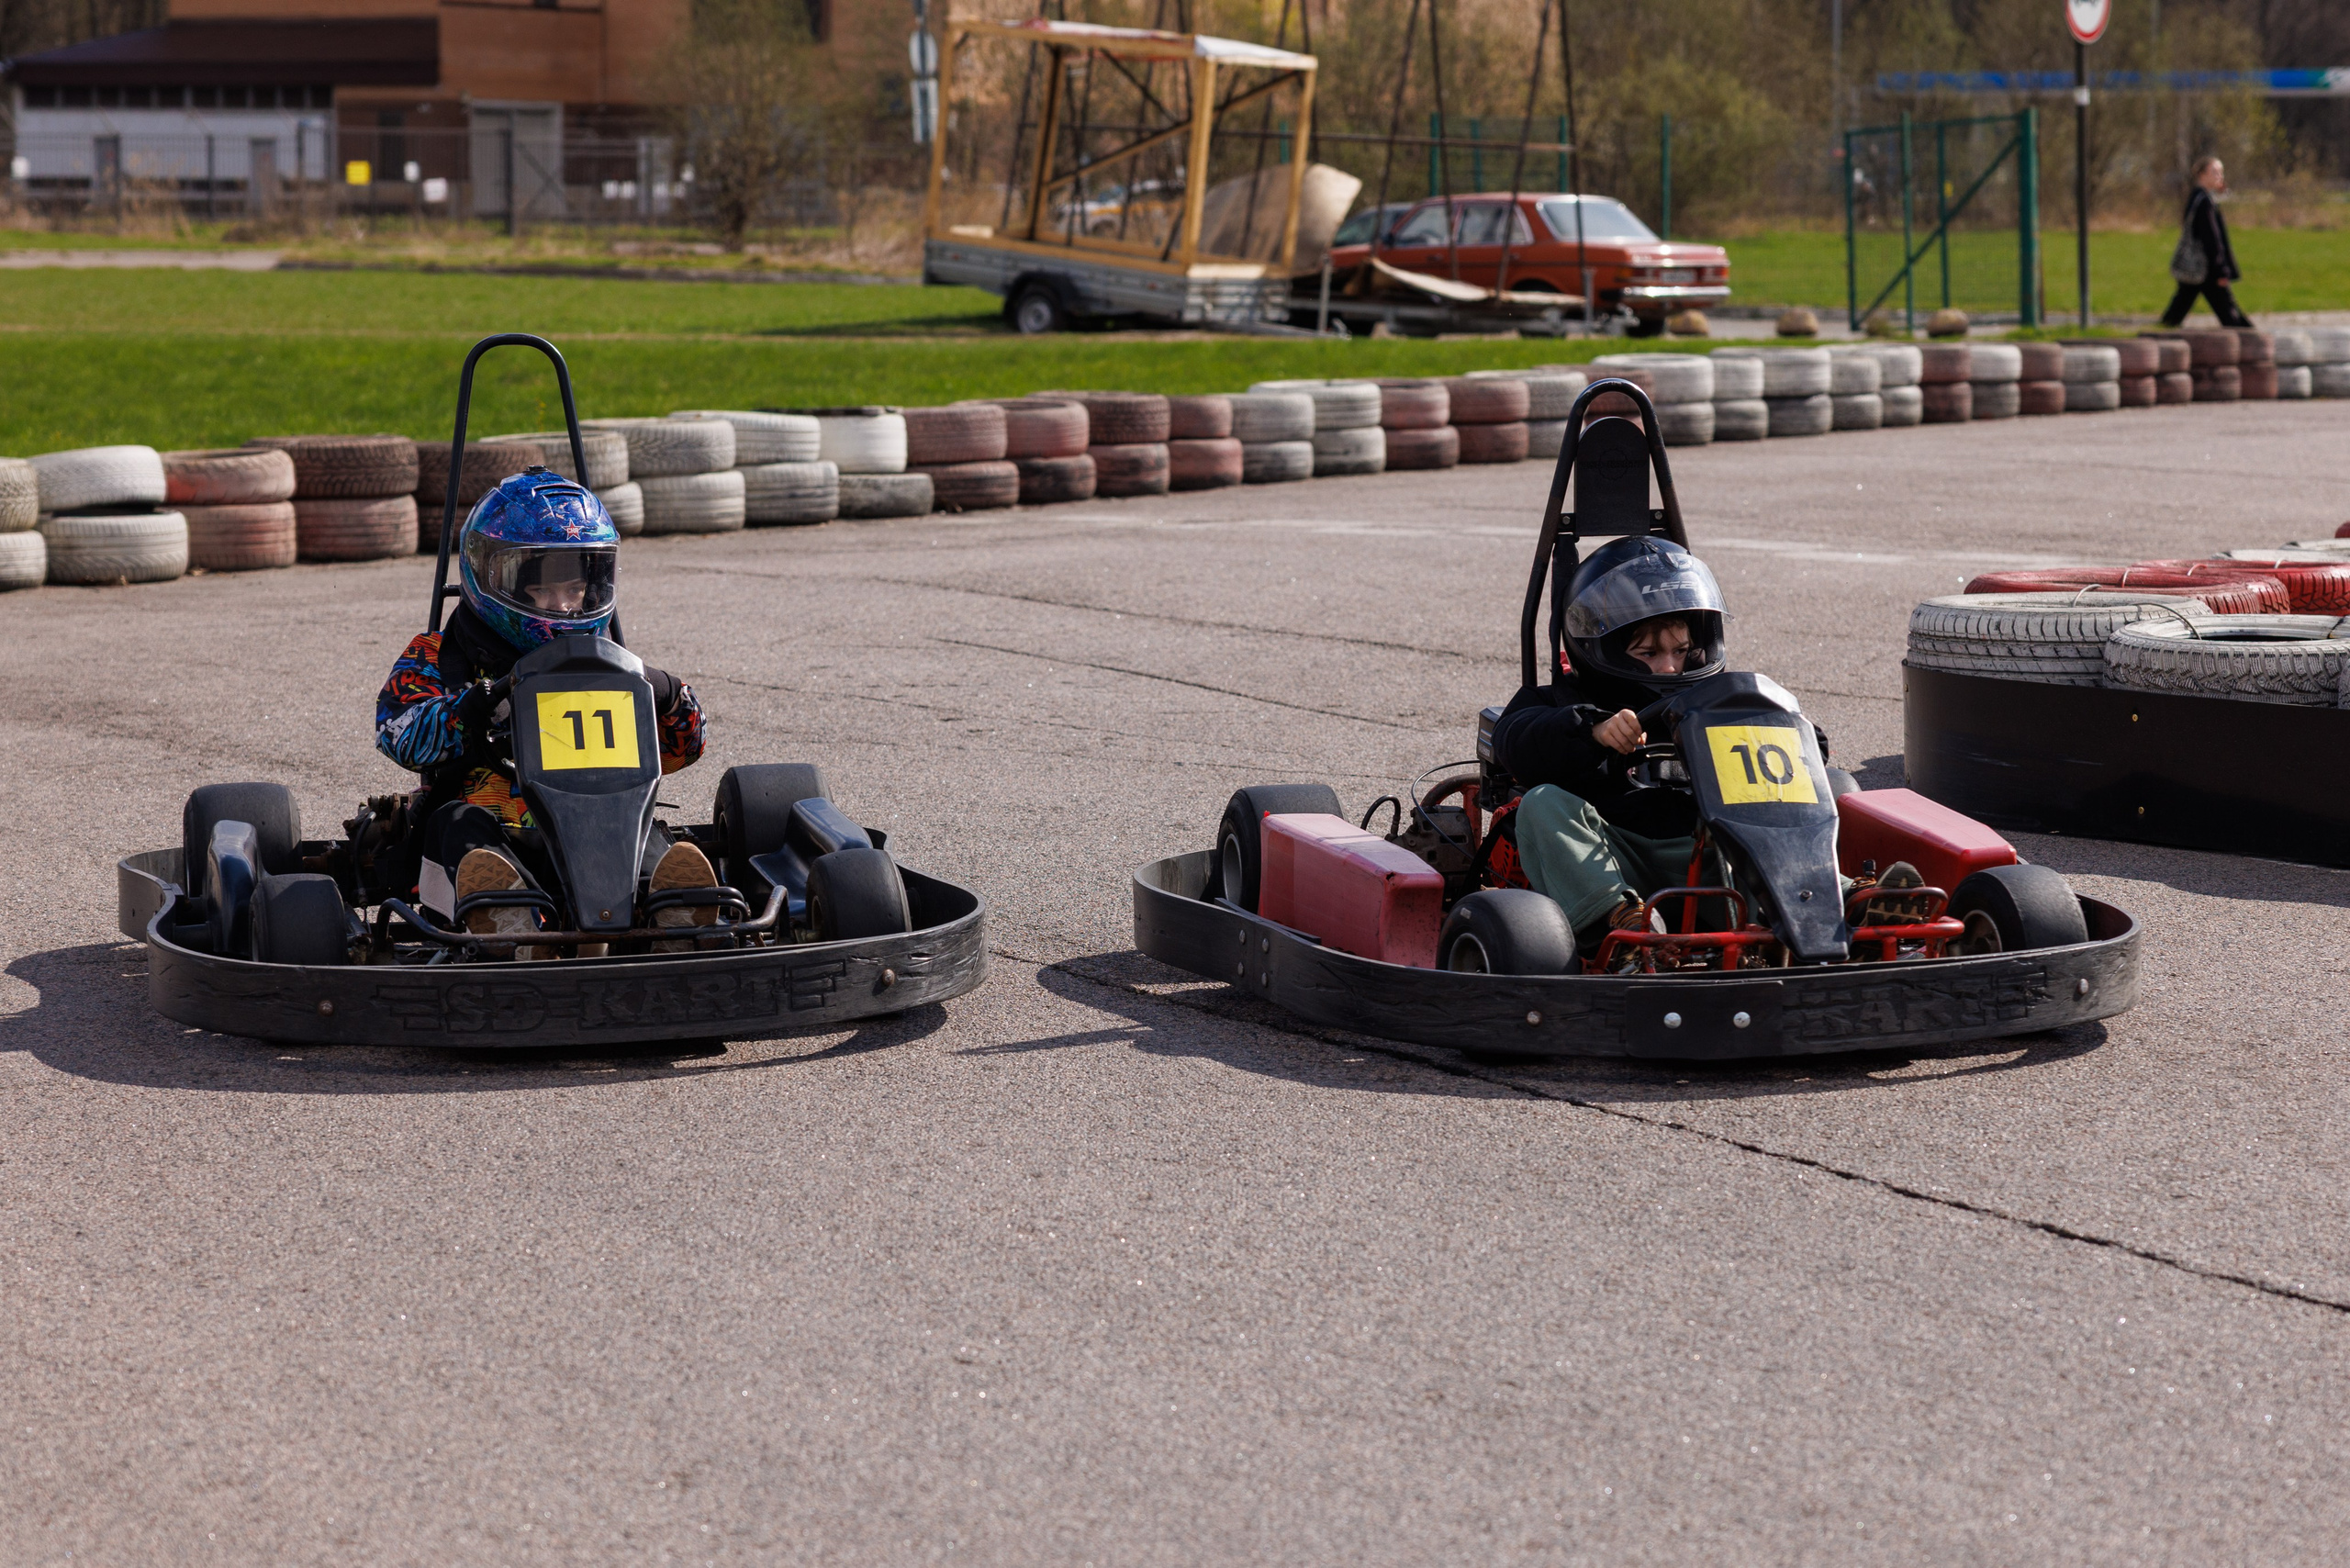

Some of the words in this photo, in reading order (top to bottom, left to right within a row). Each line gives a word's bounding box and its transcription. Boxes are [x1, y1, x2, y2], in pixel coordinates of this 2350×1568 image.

[1641, 580, 1698, 595] LS2
[562, 710, 615, 750] 11
[1729, 744, 1794, 785] 10
